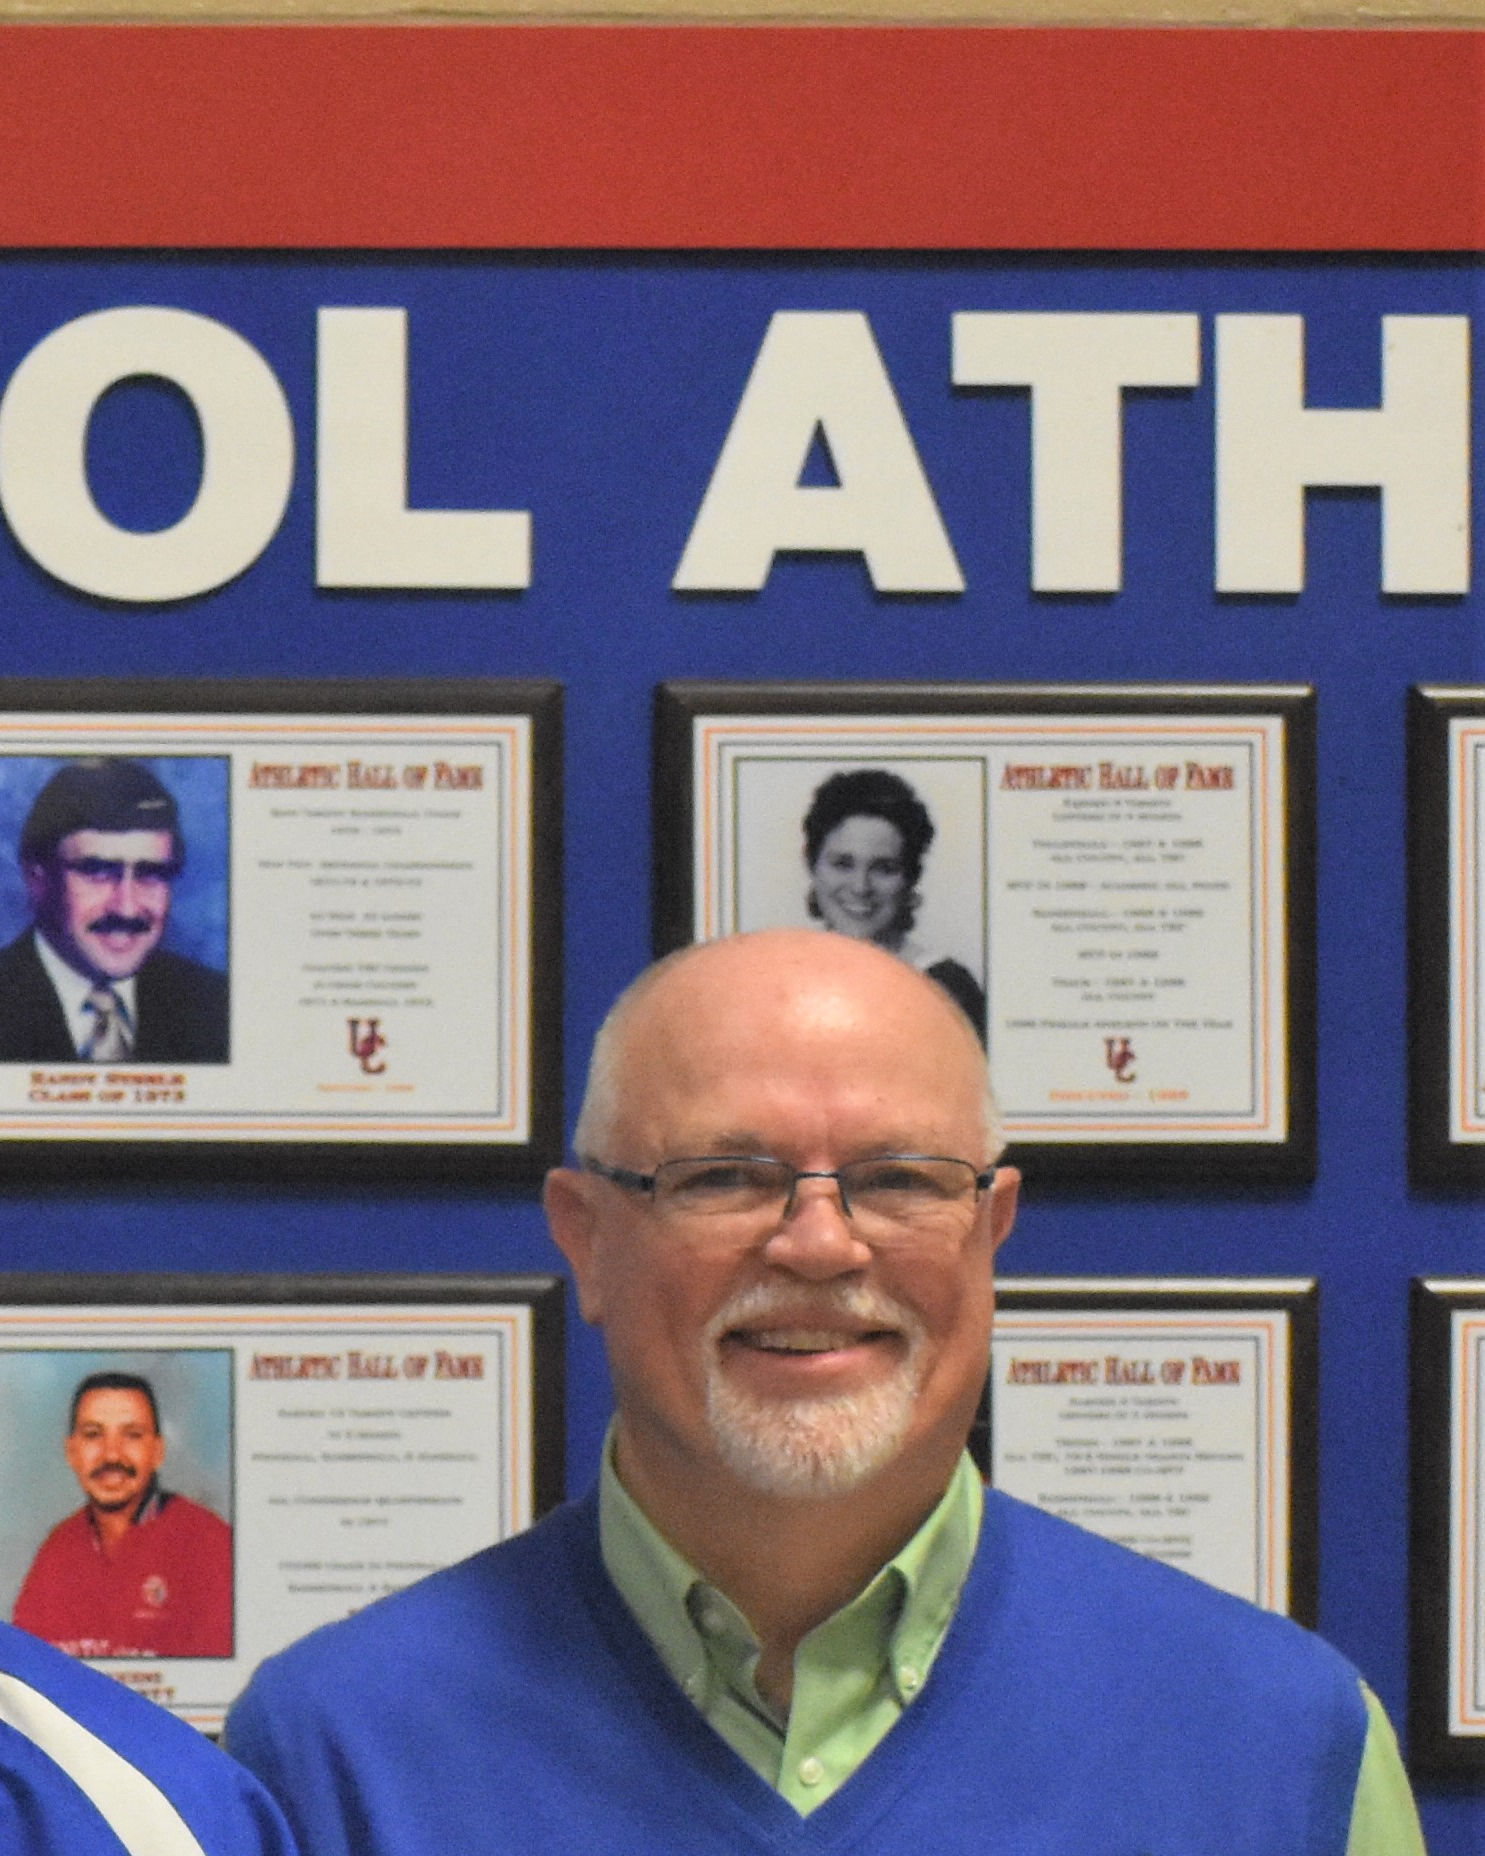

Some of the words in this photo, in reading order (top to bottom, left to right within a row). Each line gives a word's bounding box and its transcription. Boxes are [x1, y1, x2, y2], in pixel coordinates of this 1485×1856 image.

[671, 310, 1472, 595] ATH
[348, 760, 397, 789] HALL
[403, 764, 427, 789] OF
[434, 760, 483, 789] FAME
[1099, 762, 1148, 790] HALL
[1155, 766, 1179, 790] OF
[1185, 762, 1233, 790] FAME
[99, 1090, 125, 1102] OF
[348, 1351, 397, 1380] HALL
[403, 1355, 428, 1380] OF
[434, 1351, 483, 1380] FAME
[1105, 1357, 1155, 1385] HALL
[1161, 1361, 1184, 1385] OF
[1191, 1357, 1240, 1385] FAME
